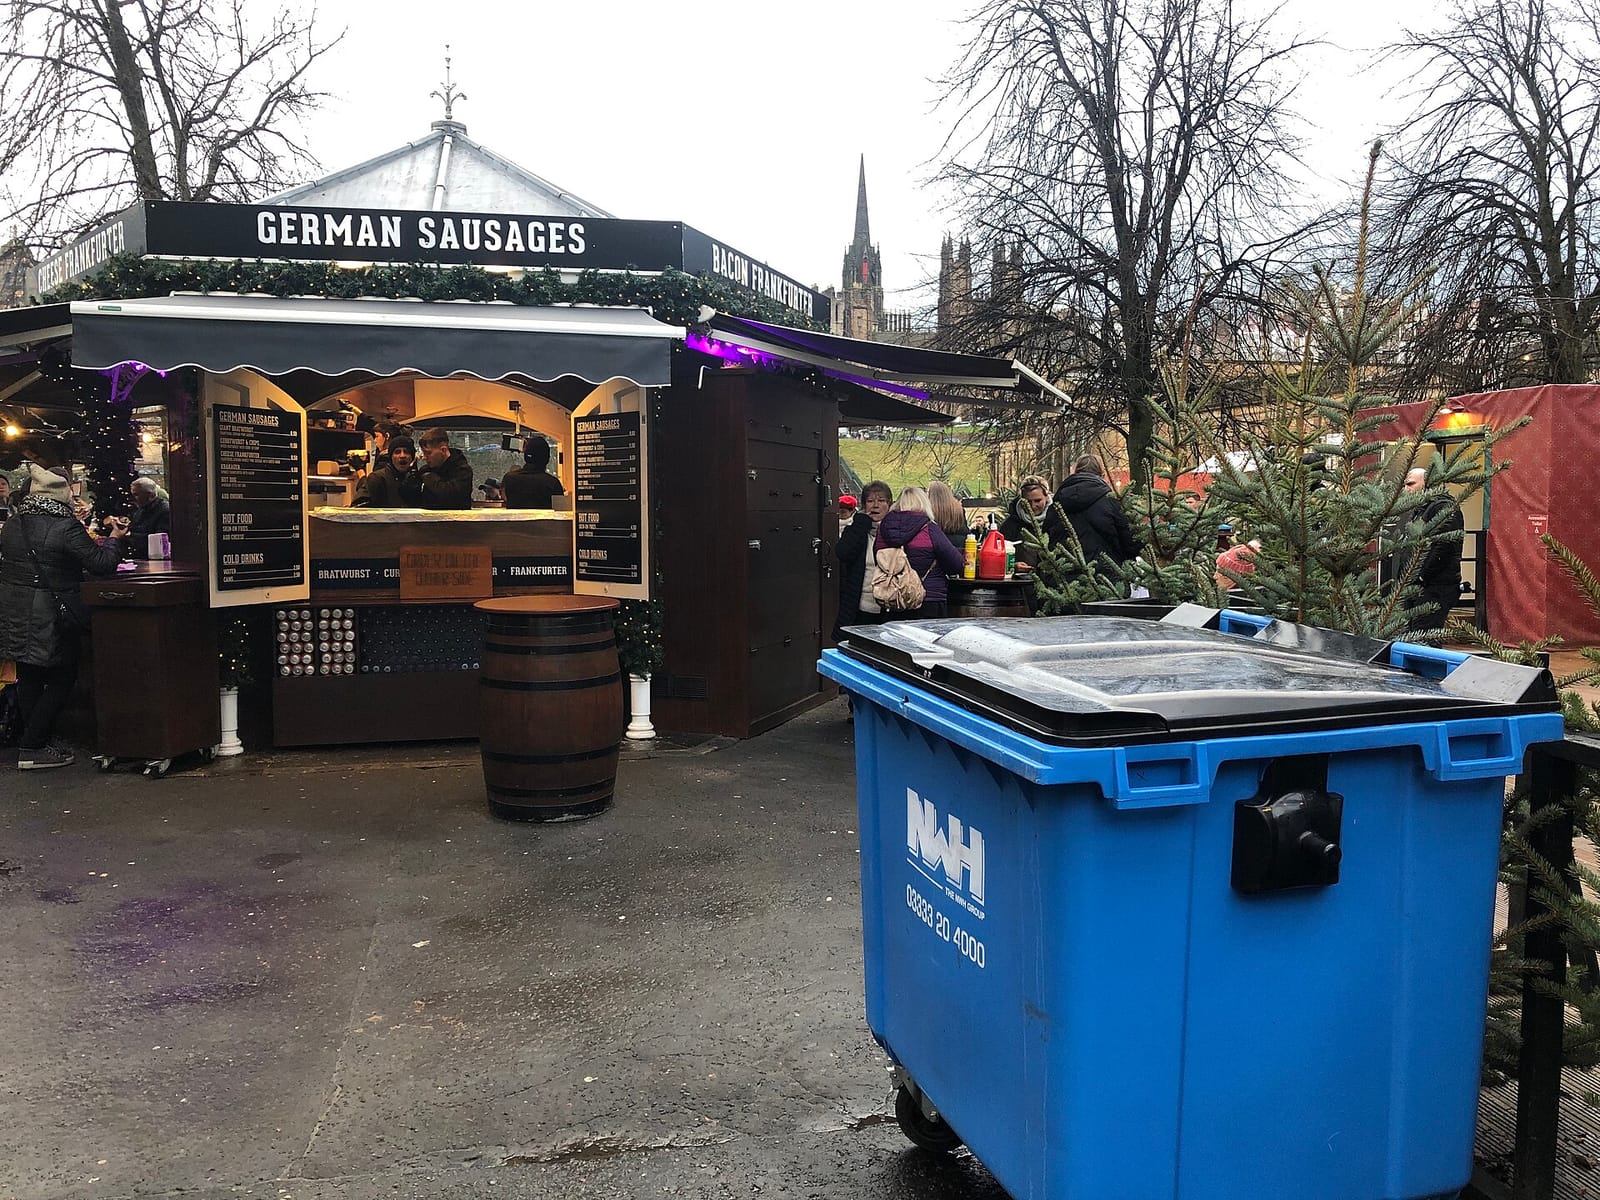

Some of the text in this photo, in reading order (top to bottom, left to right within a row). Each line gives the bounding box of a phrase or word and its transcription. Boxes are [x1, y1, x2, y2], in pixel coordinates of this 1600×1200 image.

[257, 211, 586, 254] GERMAN SAUSAGES
[38, 220, 125, 294] CHEESE FRANKFURTER
[711, 243, 813, 317] BACON FRANKFURTER
[219, 411, 279, 426] GERMAN SAUSAGES
[222, 513, 253, 524] HOT FOOD
[223, 553, 264, 564] COLD DRINKS
[318, 569, 371, 579] BRATWURST
[510, 566, 568, 576] FRANKFURTER
[906, 787, 985, 907] NWH
[945, 886, 985, 921] THE NWH GROUP
[906, 883, 985, 969] 03333 20 4000
